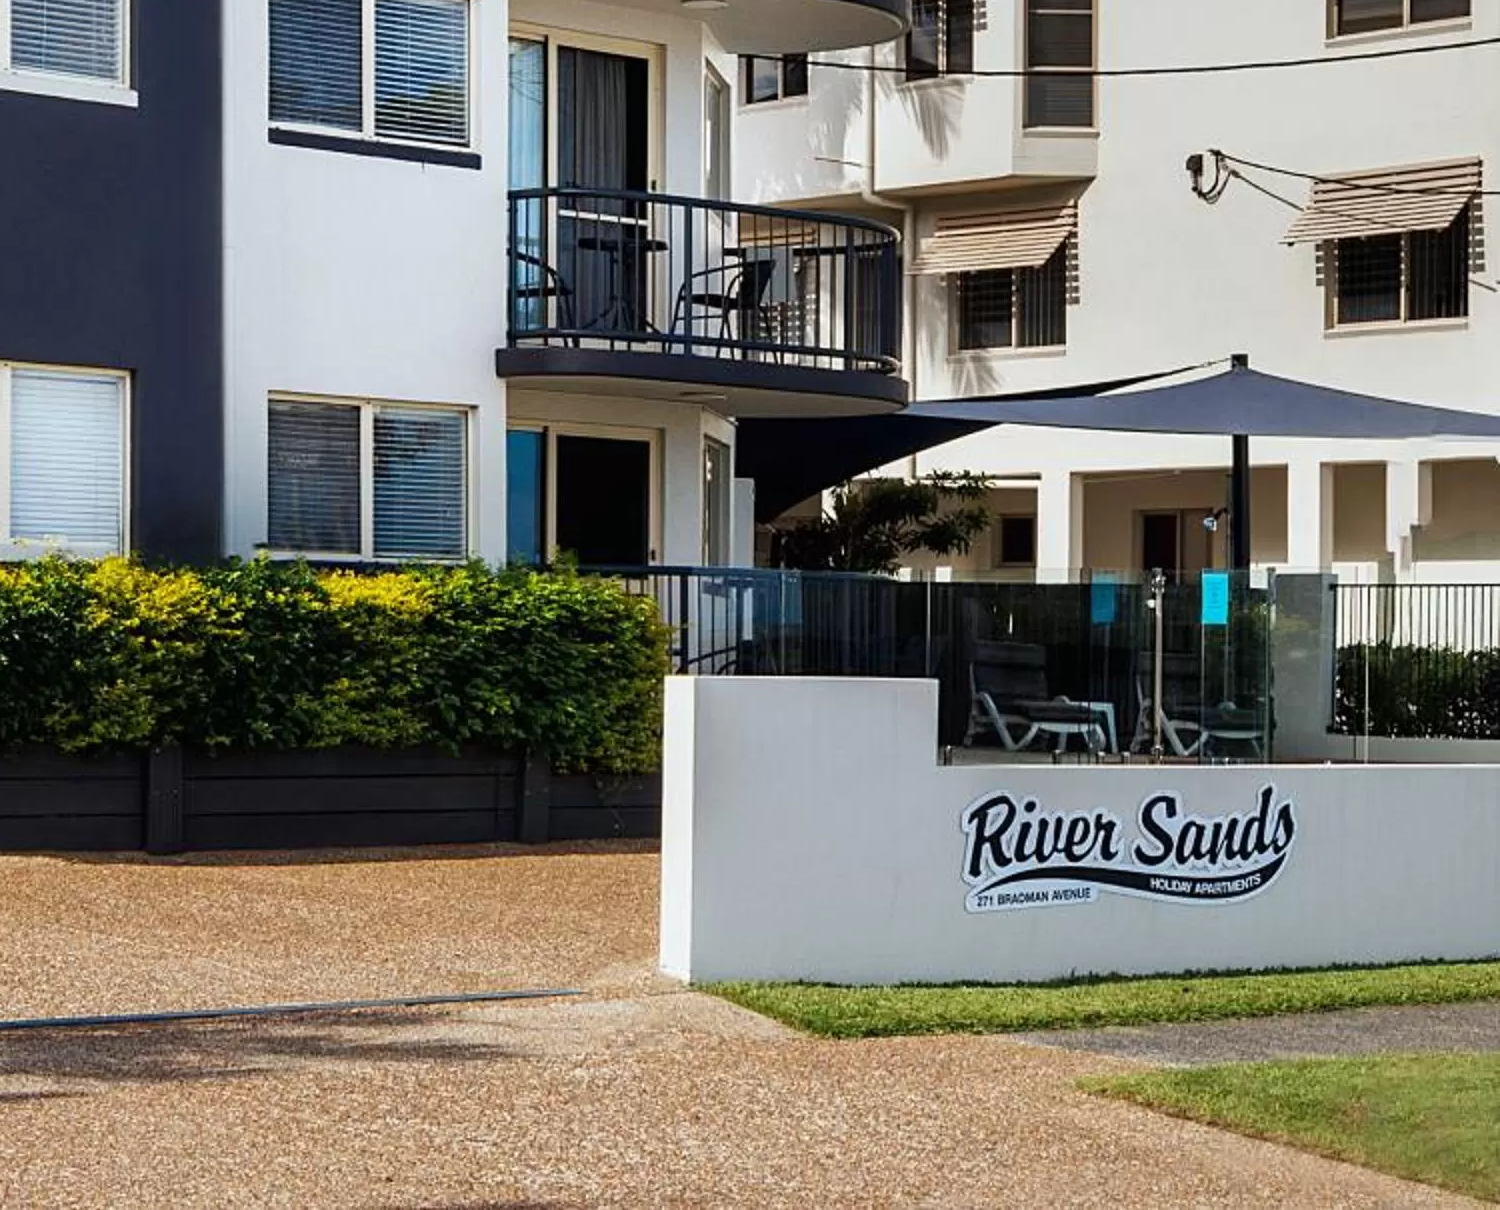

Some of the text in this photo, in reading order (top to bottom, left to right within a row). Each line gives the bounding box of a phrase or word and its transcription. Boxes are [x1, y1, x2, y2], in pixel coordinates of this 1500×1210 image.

[967, 786, 1295, 878] River Sands
[1149, 873, 1262, 895] HOLIDAY APARTMENTS
[976, 895, 994, 907] 271
[1051, 887, 1092, 902] AVENUE
